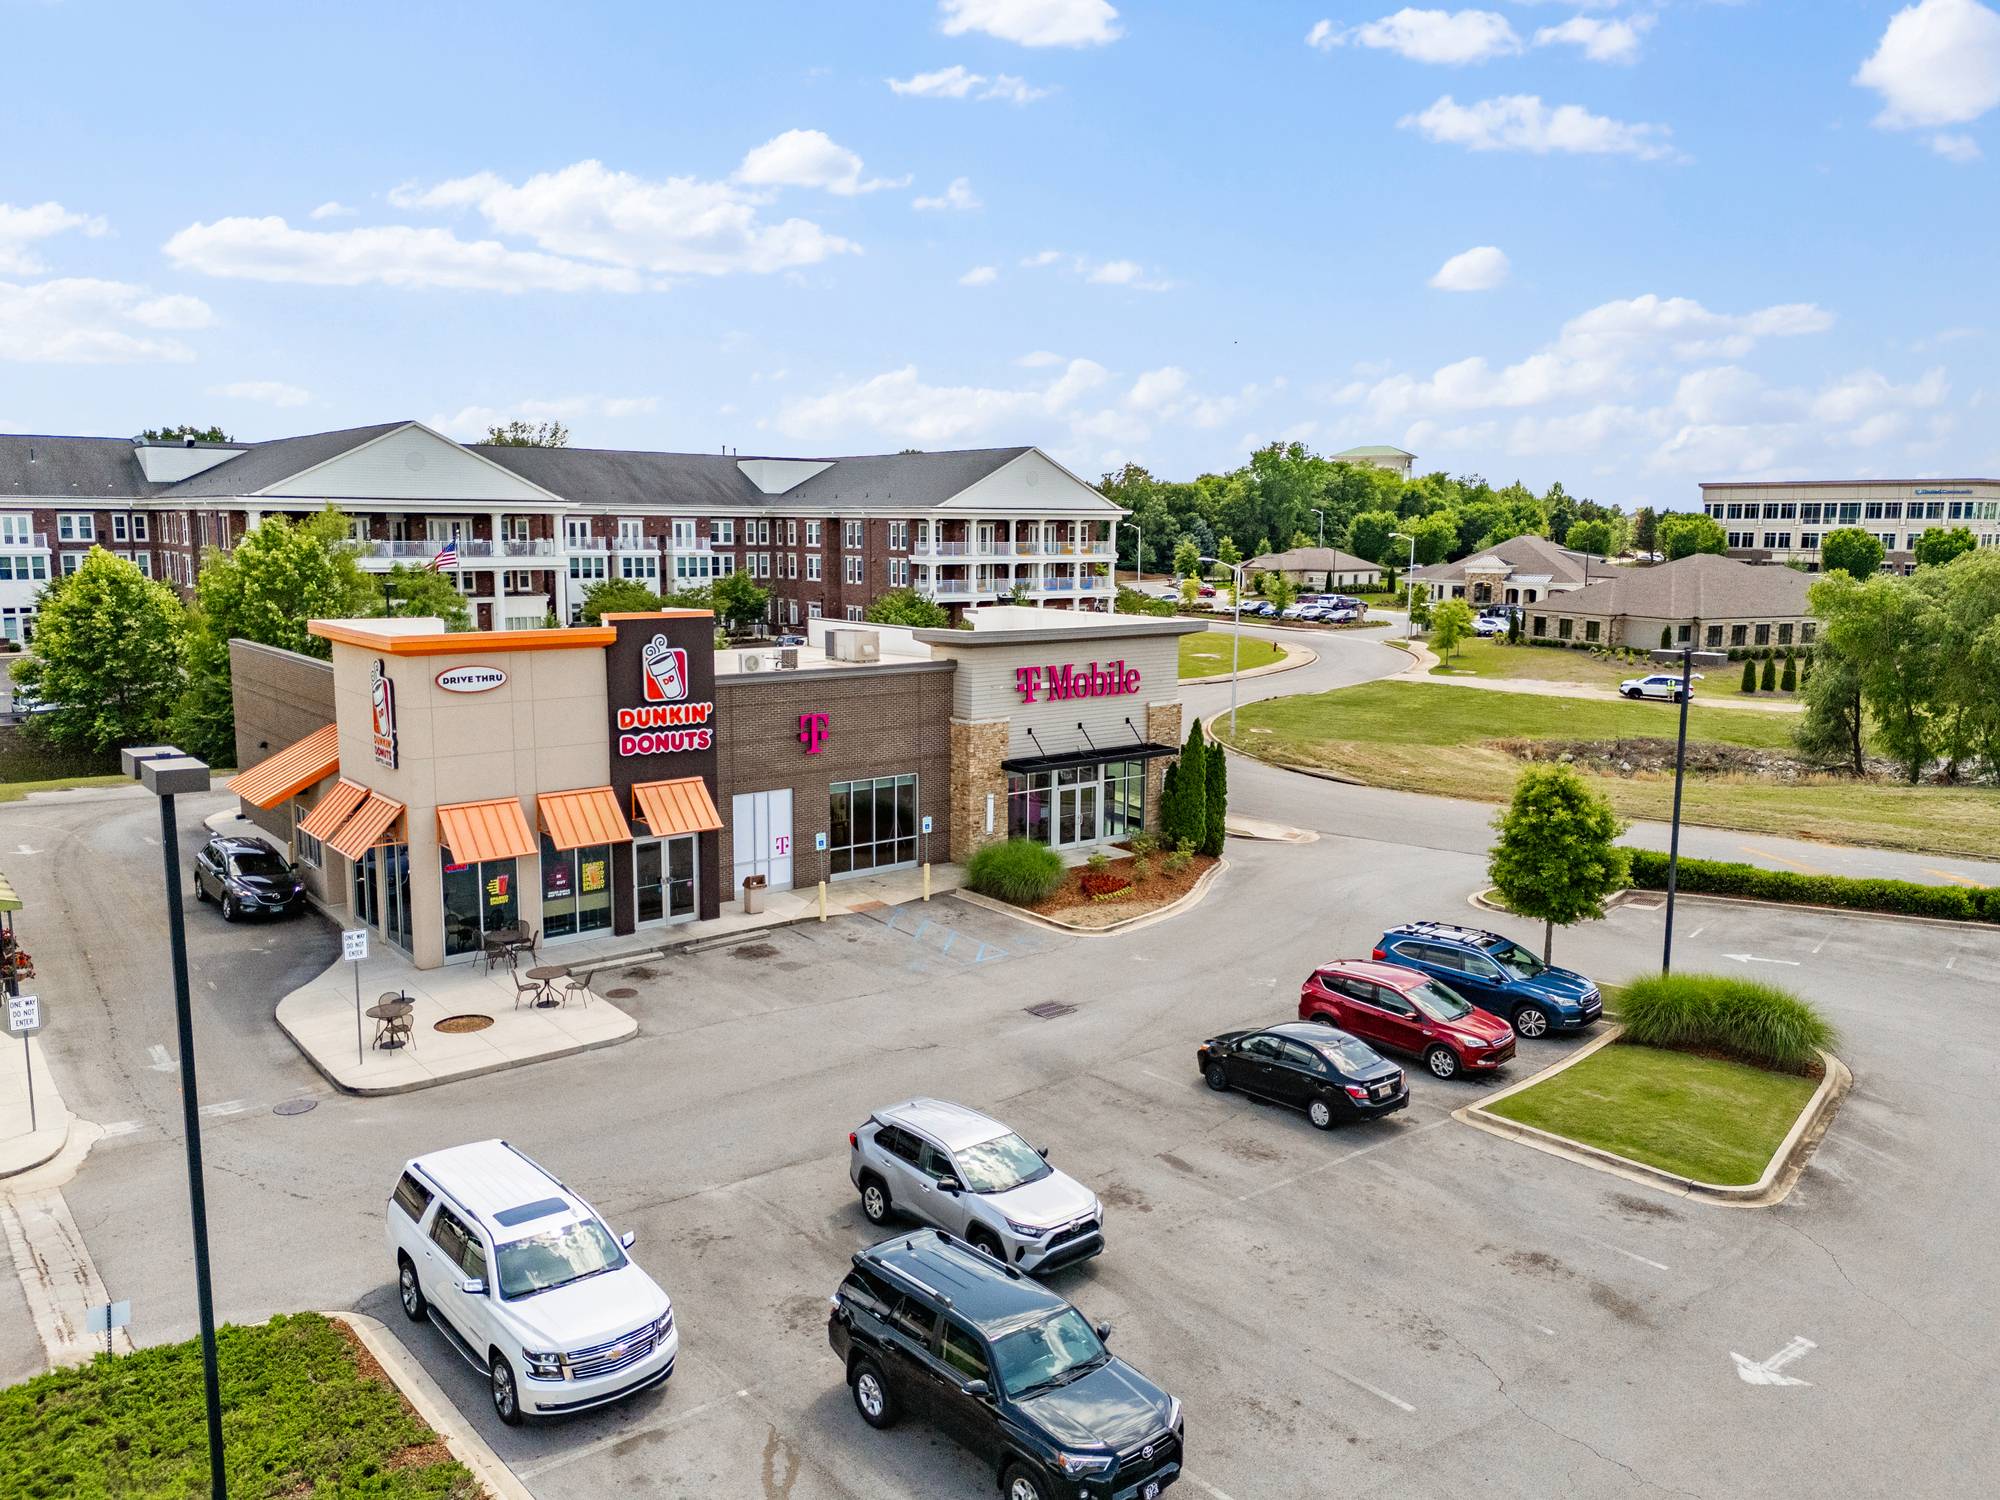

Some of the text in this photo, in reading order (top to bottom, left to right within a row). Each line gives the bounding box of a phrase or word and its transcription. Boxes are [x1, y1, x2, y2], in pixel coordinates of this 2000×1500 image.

[443, 673, 503, 685] DRIVE THRU
[663, 675, 675, 685] DD
[1046, 659, 1141, 701] Mobile
[618, 702, 713, 730] DUNKIN'
[797, 713, 830, 755] T
[620, 729, 711, 755] DONUTS
[776, 836, 789, 855] T
[345, 934, 354, 942] ONE
[10, 999, 36, 1009] ONE WAY
[15, 1018, 34, 1027] ENTER
